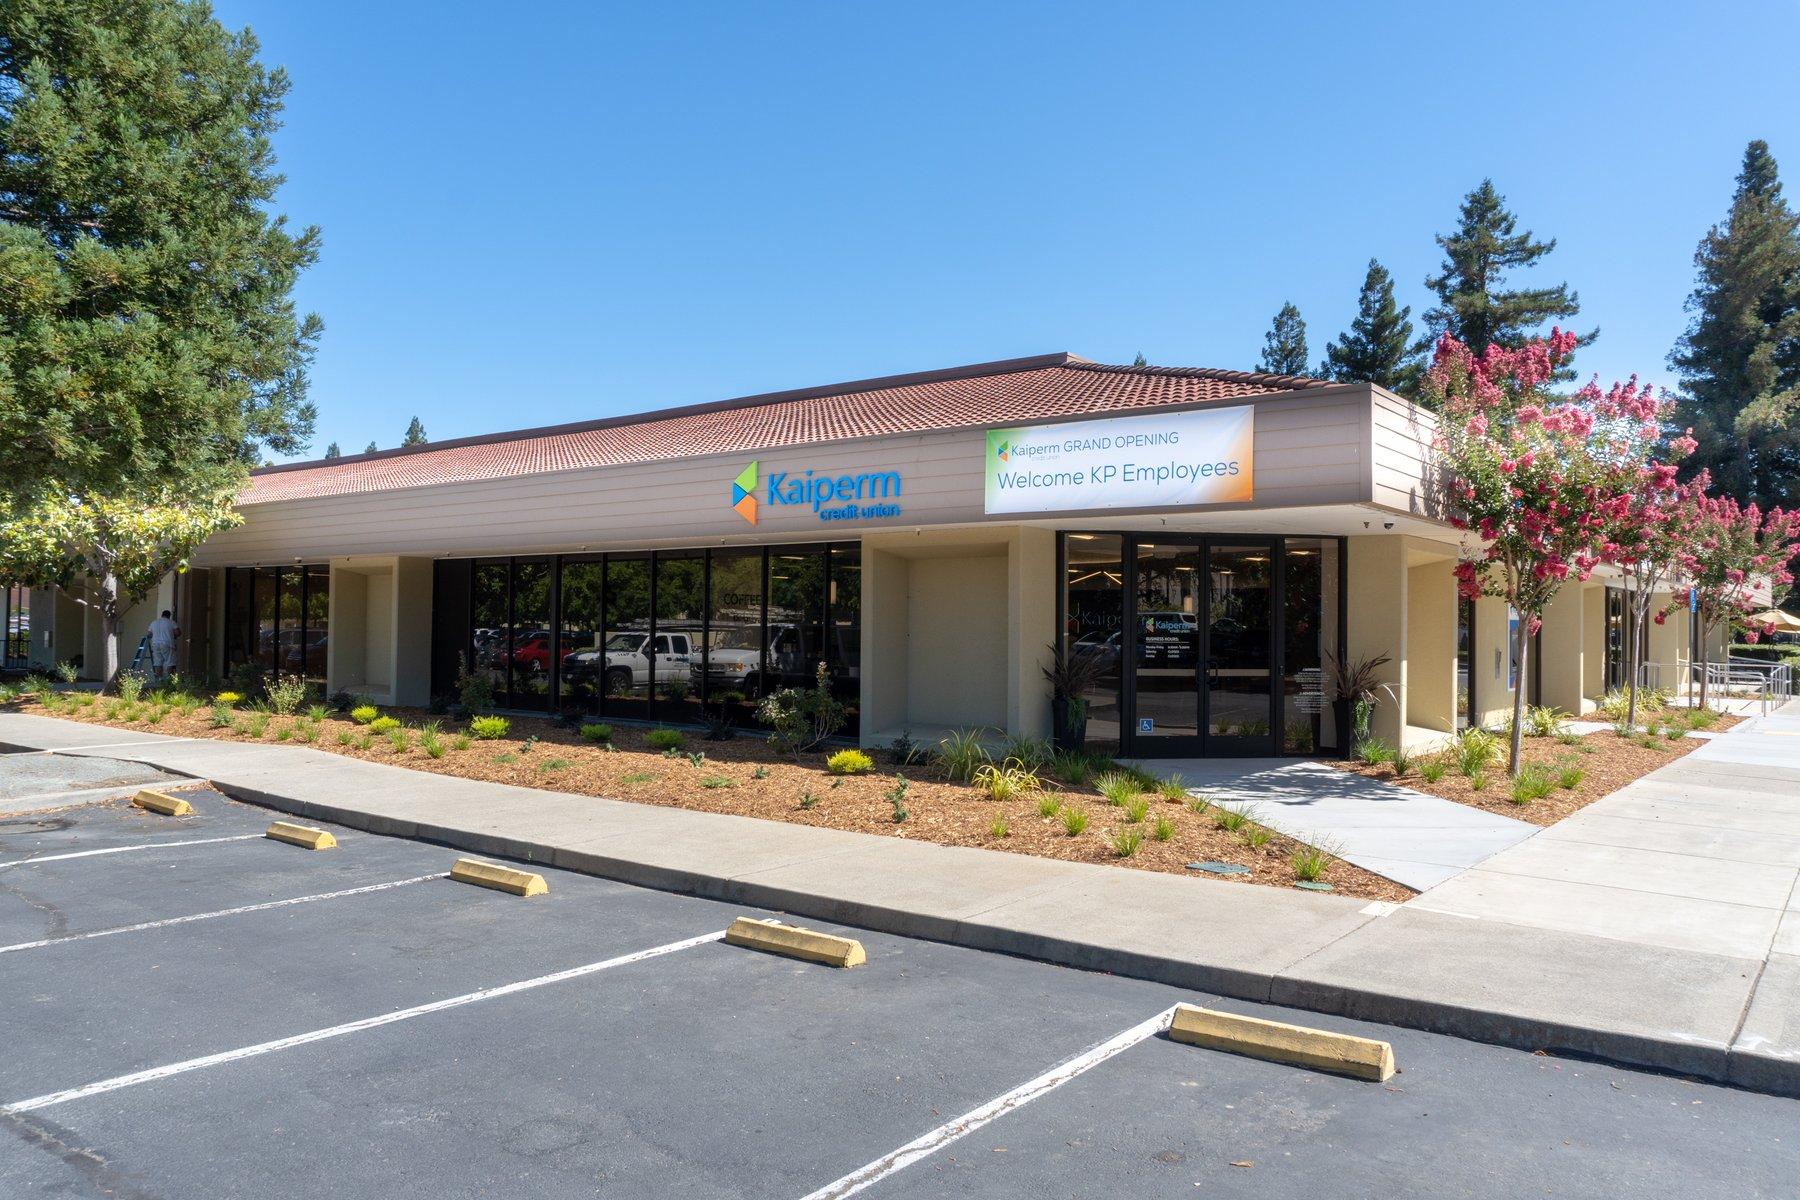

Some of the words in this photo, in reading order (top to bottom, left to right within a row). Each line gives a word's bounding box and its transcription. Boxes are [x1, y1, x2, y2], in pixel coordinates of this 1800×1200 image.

[1011, 444, 1060, 458] Kaiperm
[1063, 437, 1112, 452] GRAND
[1115, 432, 1179, 449] OPENING
[997, 470, 1084, 489] Welcome
[1090, 465, 1117, 484] KP
[1123, 461, 1240, 486] Employees
[767, 470, 902, 513] Kaiperm
[819, 505, 858, 521] credit
[861, 503, 902, 520] union
[1155, 620, 1190, 631] Kaiperm
